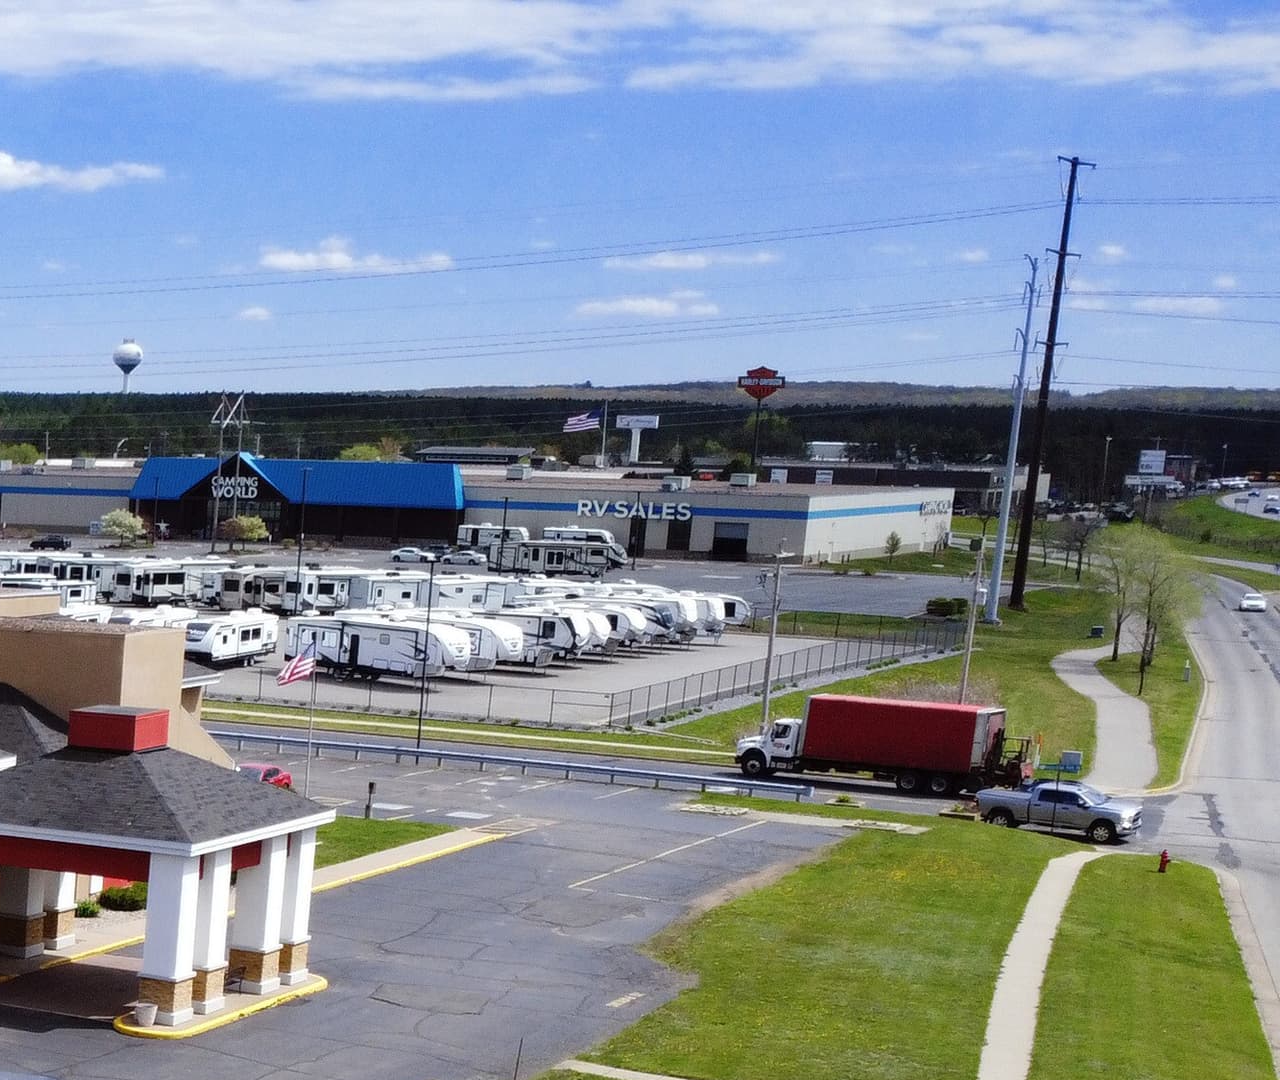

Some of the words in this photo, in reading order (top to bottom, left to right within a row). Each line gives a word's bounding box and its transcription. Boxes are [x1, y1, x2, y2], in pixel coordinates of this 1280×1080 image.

[211, 476, 258, 487] CAMPING
[211, 486, 258, 499] WORLD
[576, 499, 610, 518] RV
[613, 500, 692, 521] SALES
